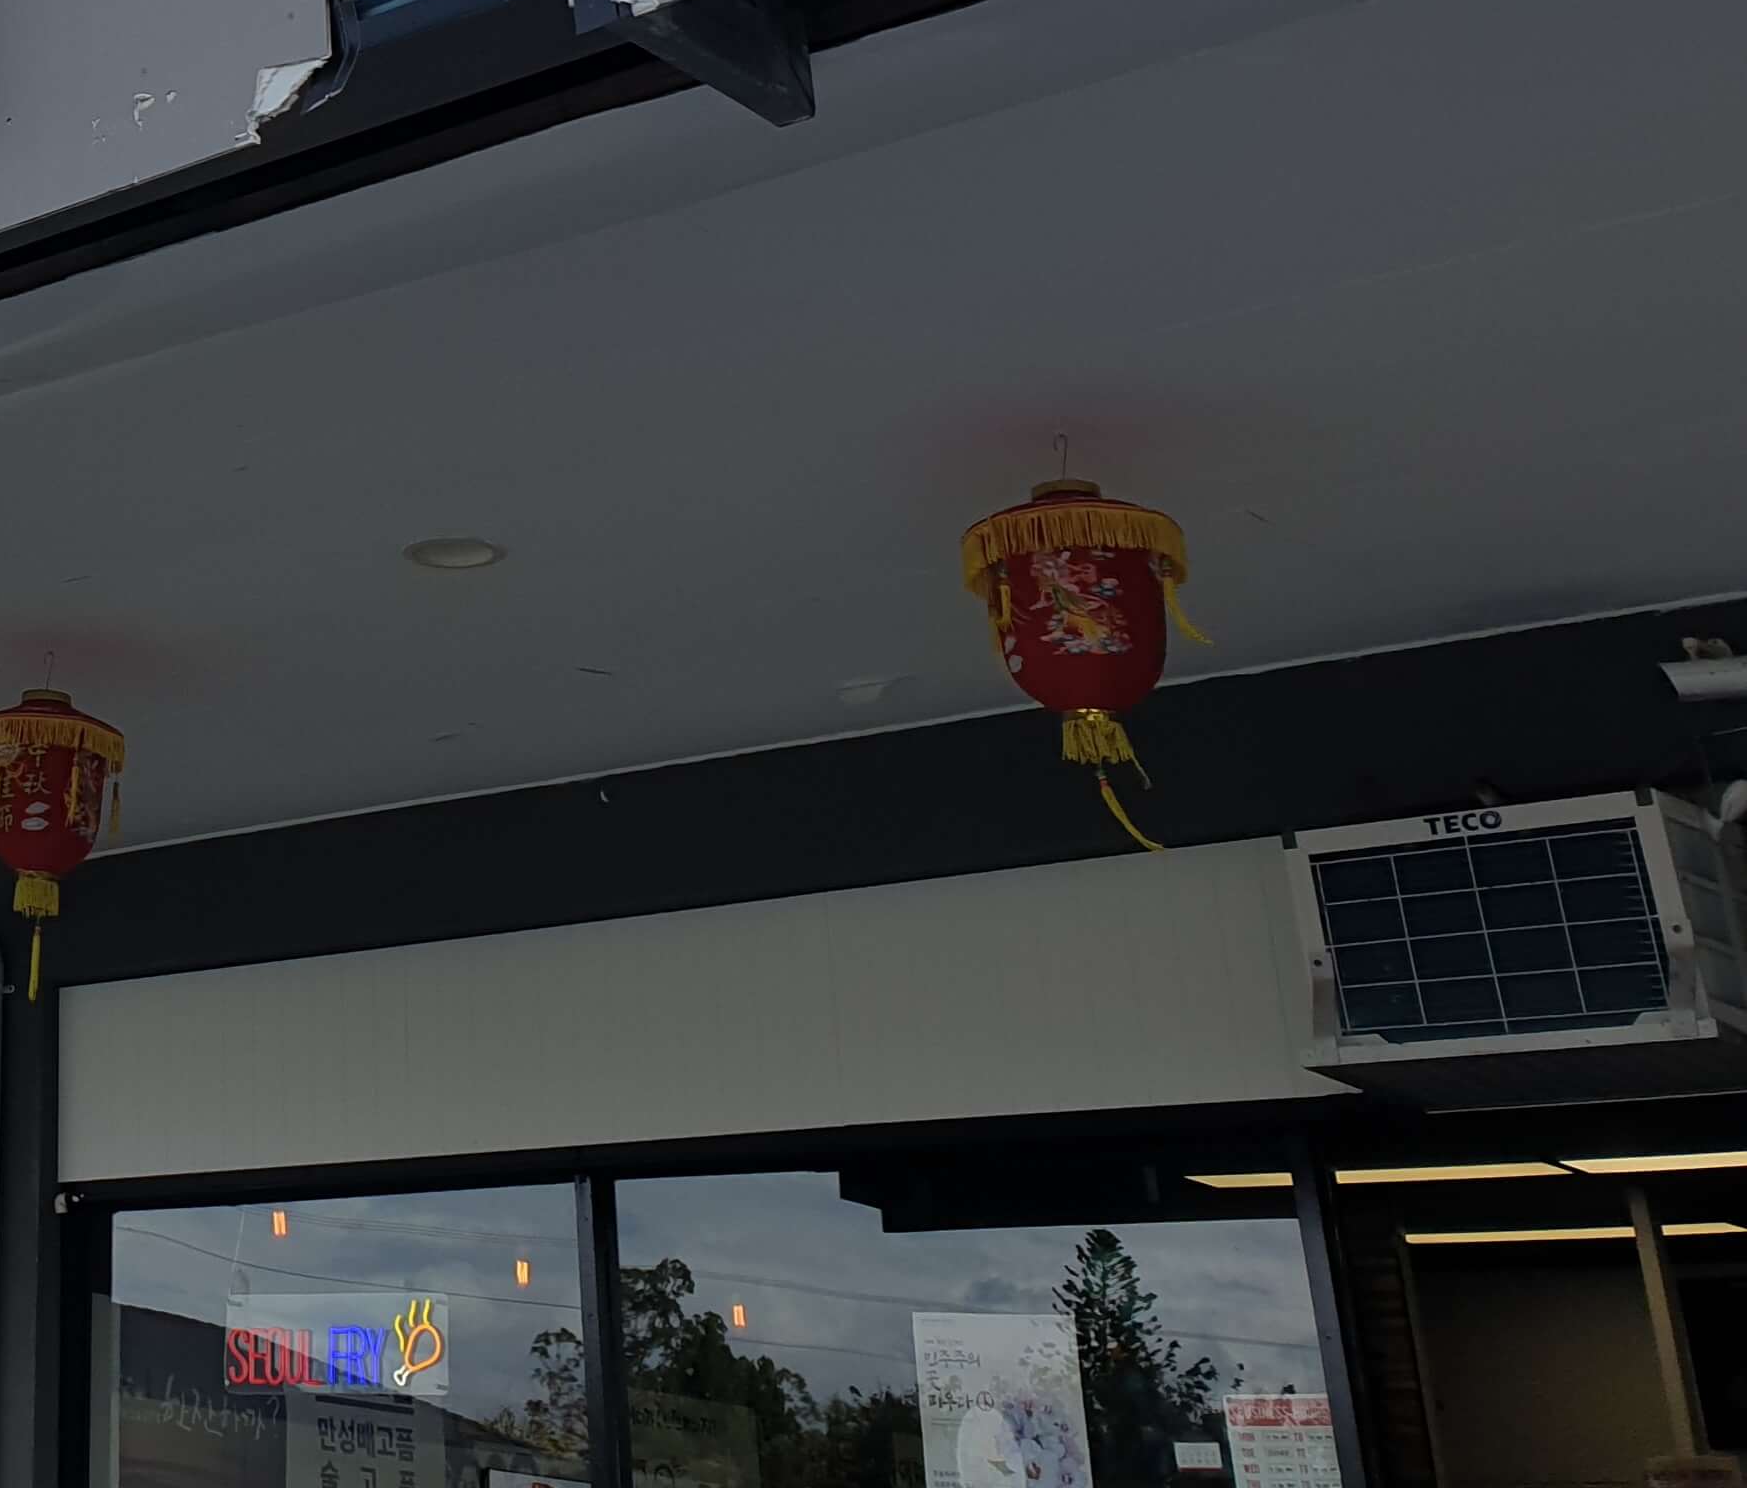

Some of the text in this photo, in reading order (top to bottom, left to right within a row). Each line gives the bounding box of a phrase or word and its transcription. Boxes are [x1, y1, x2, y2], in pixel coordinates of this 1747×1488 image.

[1423, 810, 1501, 835] TECO
[227, 1326, 386, 1387] SEOUL FRY
